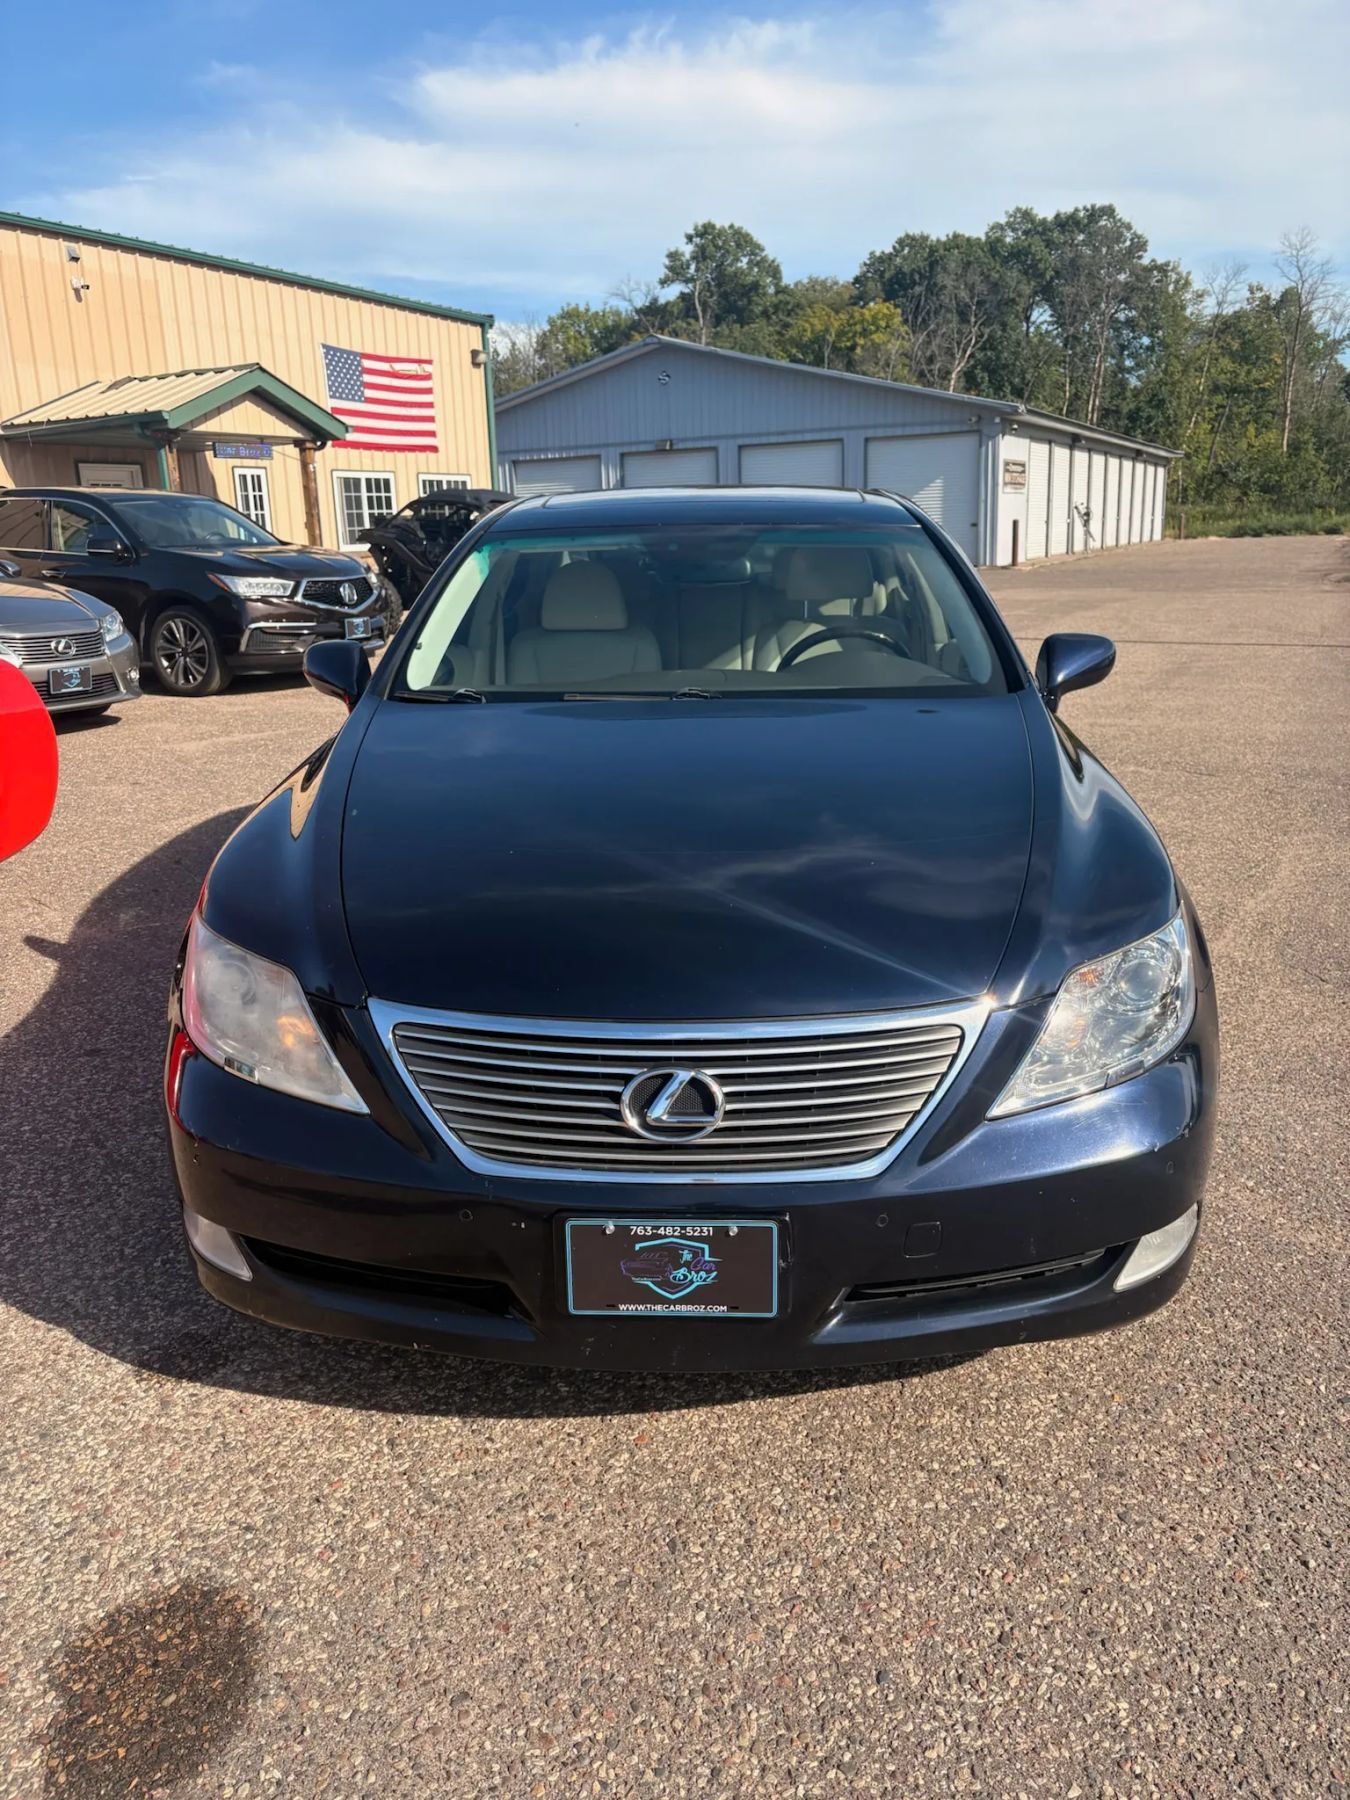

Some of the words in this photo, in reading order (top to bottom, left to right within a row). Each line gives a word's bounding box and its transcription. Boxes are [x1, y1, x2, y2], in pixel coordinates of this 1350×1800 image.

[630, 1226, 713, 1236] 763-482-5231
[679, 1250, 693, 1264] The
[690, 1257, 717, 1271] Car
[670, 1267, 718, 1284] Broz
[618, 1303, 728, 1312] WWW.THECARBROZ.COM
